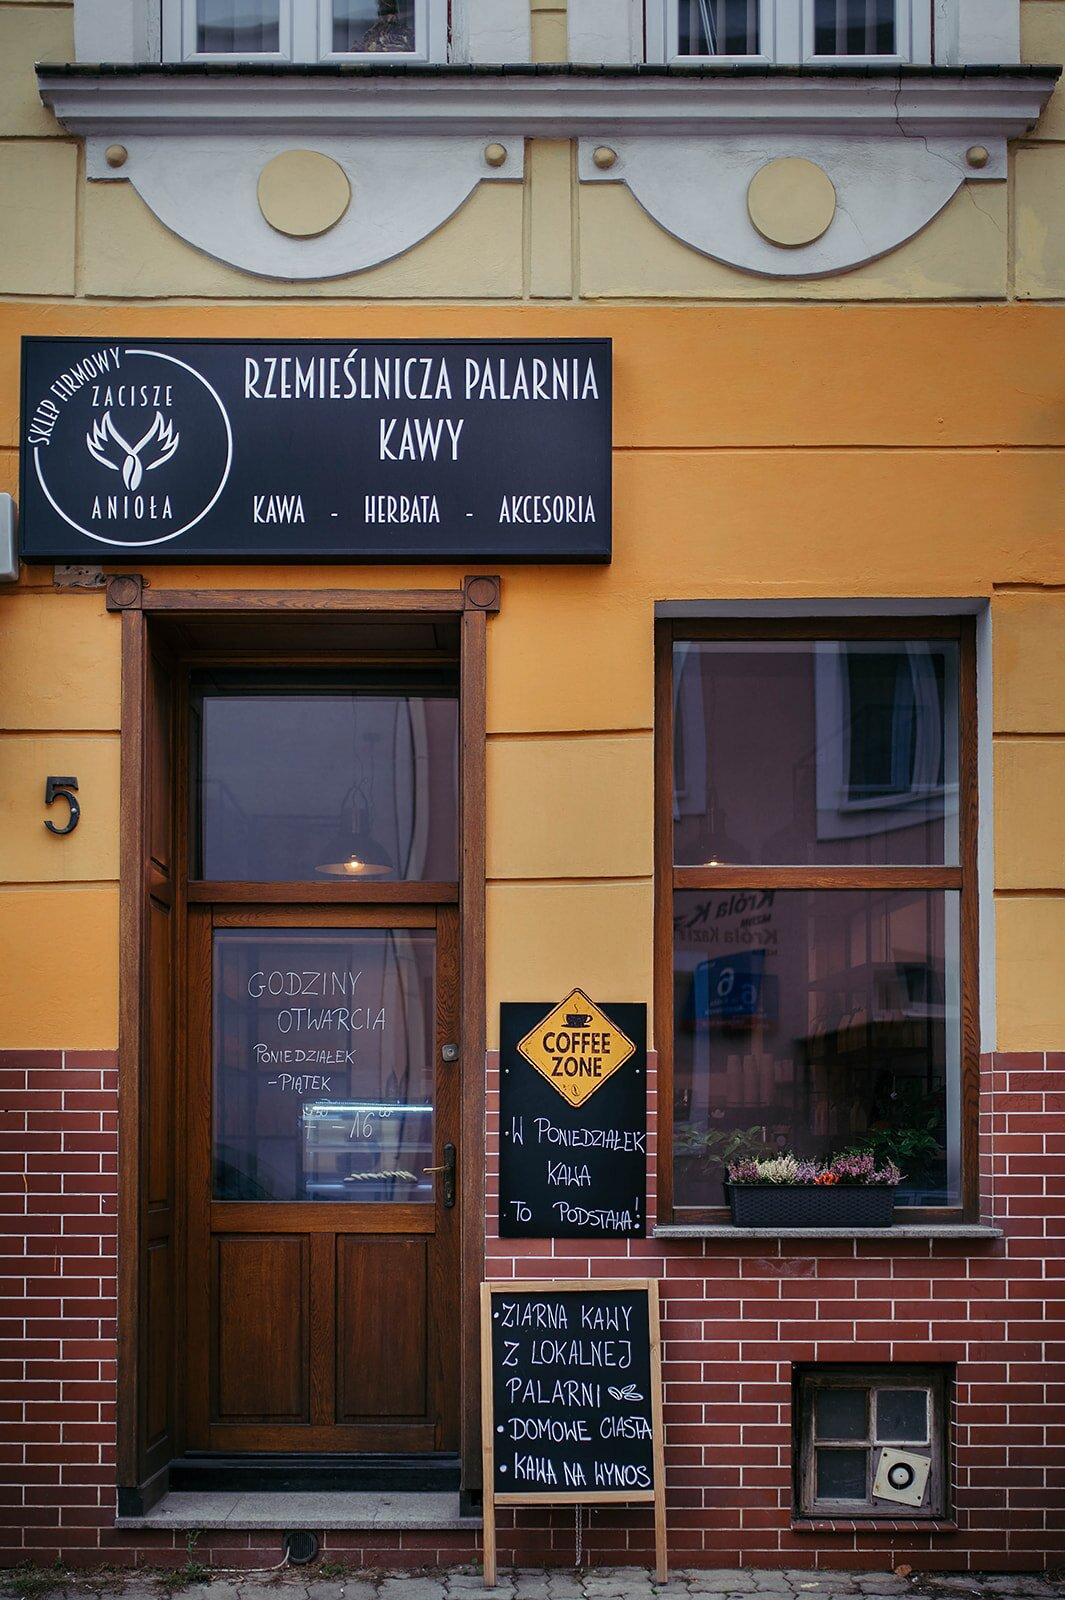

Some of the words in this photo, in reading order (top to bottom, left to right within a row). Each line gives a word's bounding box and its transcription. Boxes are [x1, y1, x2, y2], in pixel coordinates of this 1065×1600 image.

[244, 348, 452, 401] RZEMIEŚLNICZA
[464, 358, 600, 401] PALARNIA
[28, 399, 60, 446] SKLEP
[50, 346, 120, 402] FIRMOWY
[91, 385, 173, 407] ZACISZE
[379, 418, 465, 461] KAWY
[91, 495, 173, 519] ANIOŁA
[252, 495, 306, 524] KAWA
[364, 495, 440, 524] HERBATA
[499, 495, 597, 524] AKCESORIA
[44, 776, 80, 835] 5
[247, 971, 362, 998] GODZINY
[277, 1007, 386, 1033] OTWARCIA
[542, 1031, 611, 1054] COFFEE
[551, 1056, 603, 1077] ZONE
[547, 1160, 591, 1186] KAWA
[501, 1302, 568, 1329] ZIARNA
[581, 1304, 632, 1331] KAWY
[502, 1341, 520, 1366] Z
[531, 1340, 632, 1369] LOKALNEJ
[505, 1377, 600, 1408] PALARNI
[508, 1417, 592, 1441] DOMOWE
[600, 1416, 653, 1440] CIASTA
[514, 1452, 558, 1485] KAWA
[563, 1461, 587, 1487] NA
[595, 1460, 651, 1488] WYNOS
